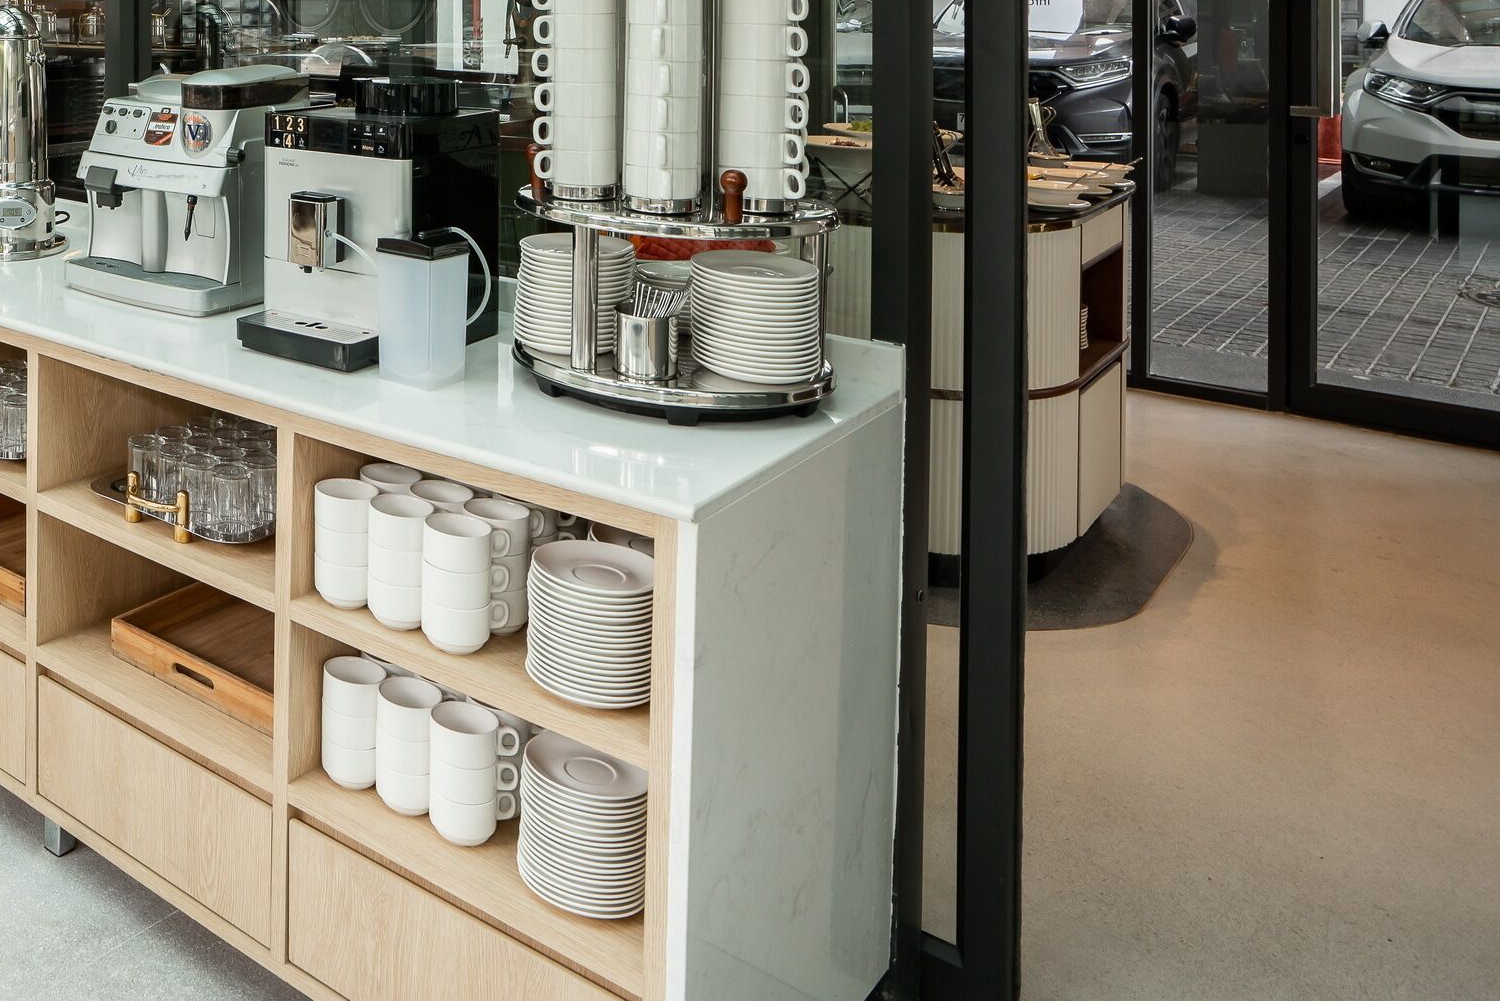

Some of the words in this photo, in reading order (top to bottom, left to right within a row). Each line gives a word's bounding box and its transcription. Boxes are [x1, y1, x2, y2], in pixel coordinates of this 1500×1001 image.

[274, 116, 280, 132] 1
[286, 116, 293, 131] 2
[297, 117, 304, 132] 3
